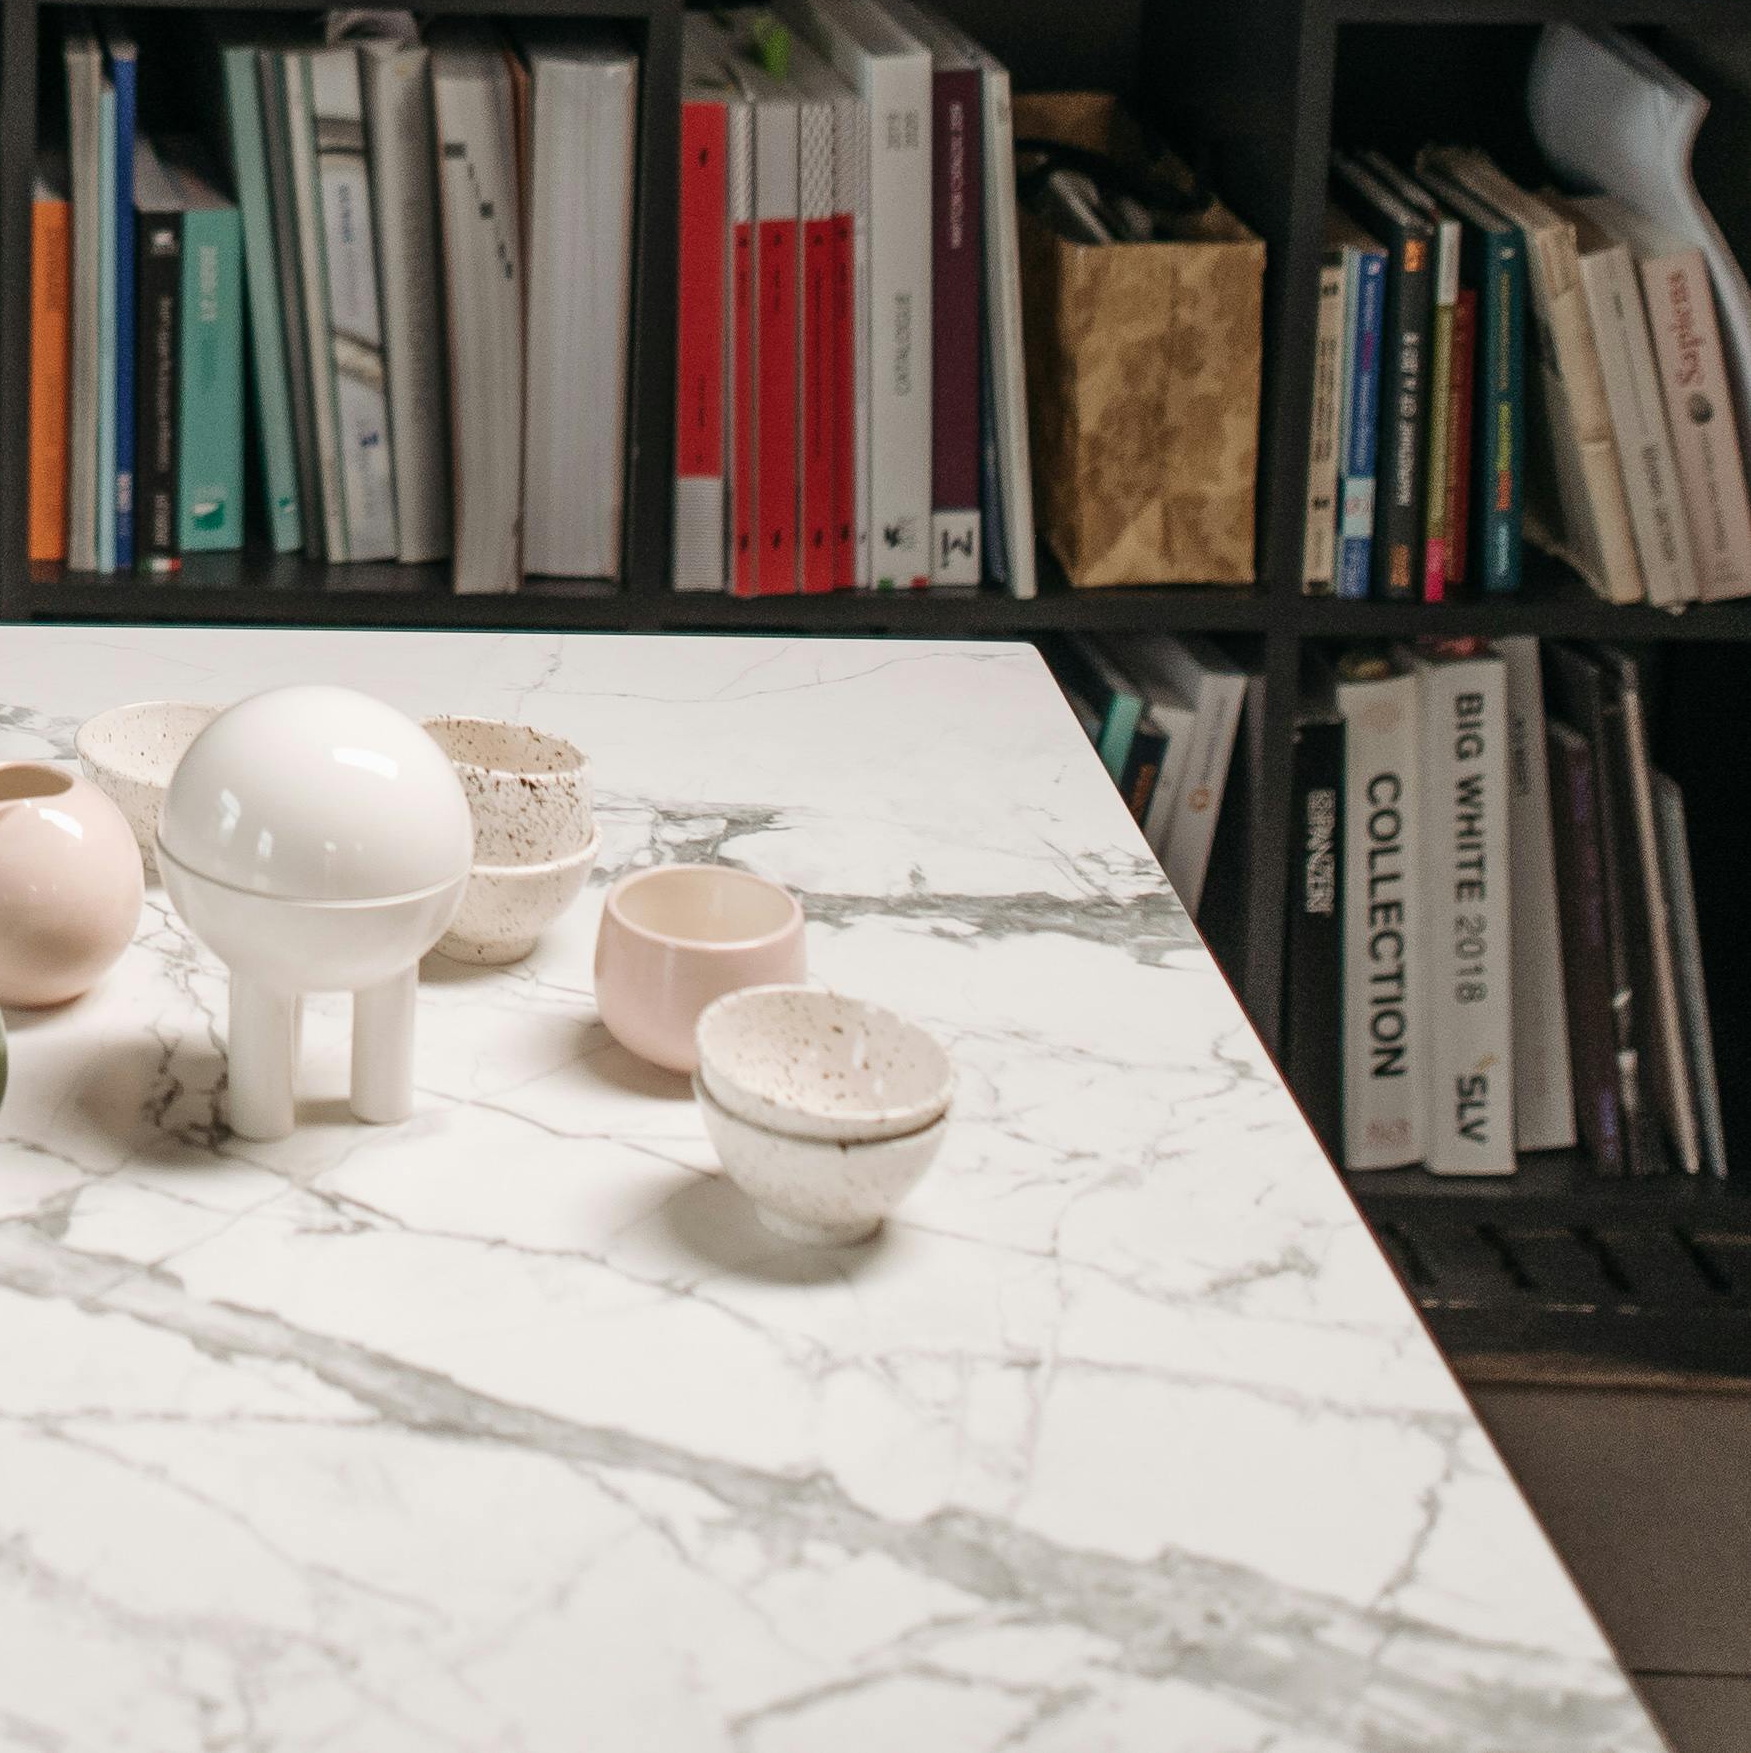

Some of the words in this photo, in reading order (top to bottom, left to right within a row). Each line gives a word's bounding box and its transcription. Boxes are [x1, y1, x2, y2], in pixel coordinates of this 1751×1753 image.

[1454, 691, 1485, 763] BIG
[1454, 773, 1487, 904] WHITE
[1365, 771, 1409, 1081] COLLECTION
[1455, 915, 1486, 1004] 2018
[1454, 1072, 1489, 1146] SLV
